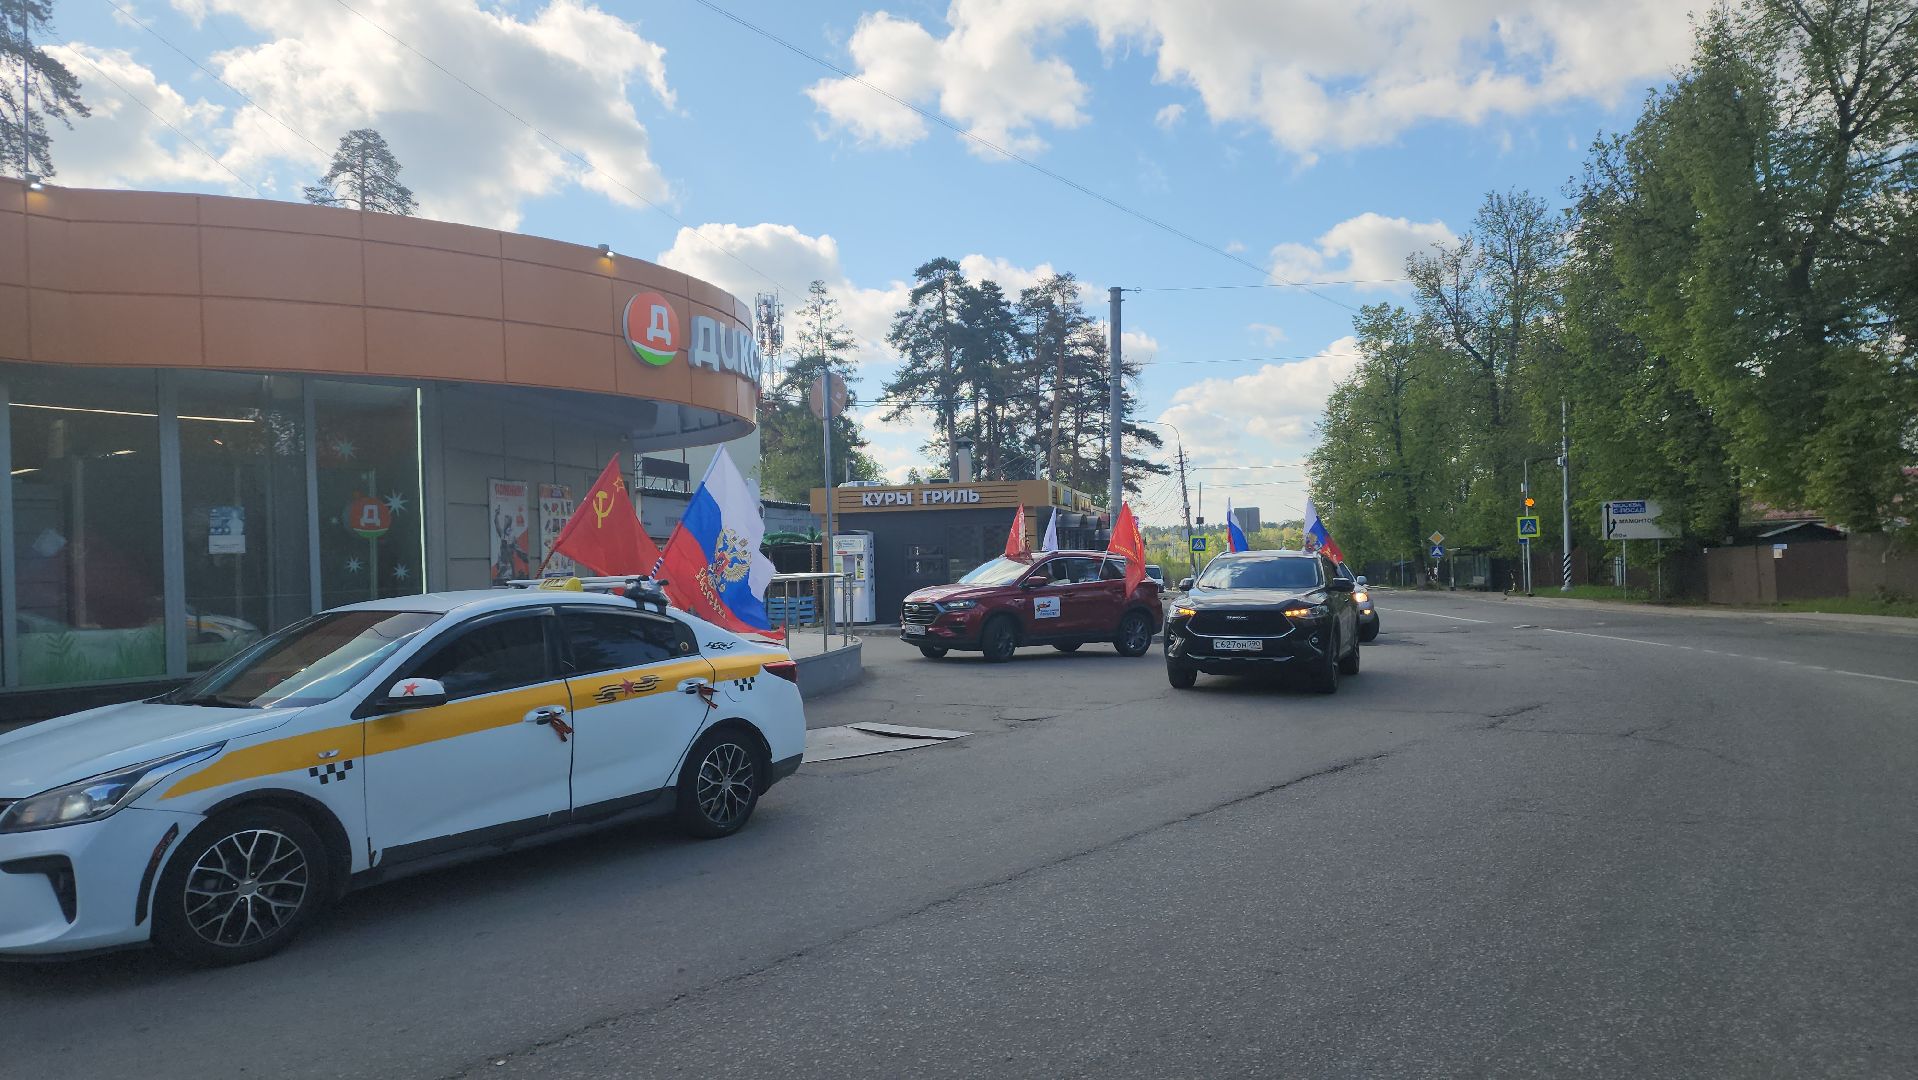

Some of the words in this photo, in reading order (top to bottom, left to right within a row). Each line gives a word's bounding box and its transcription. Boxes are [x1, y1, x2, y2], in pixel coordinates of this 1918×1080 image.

[646, 304, 672, 346] Д
[862, 491, 912, 506] КУРЫ
[922, 489, 980, 504] ГРИЛЬ
